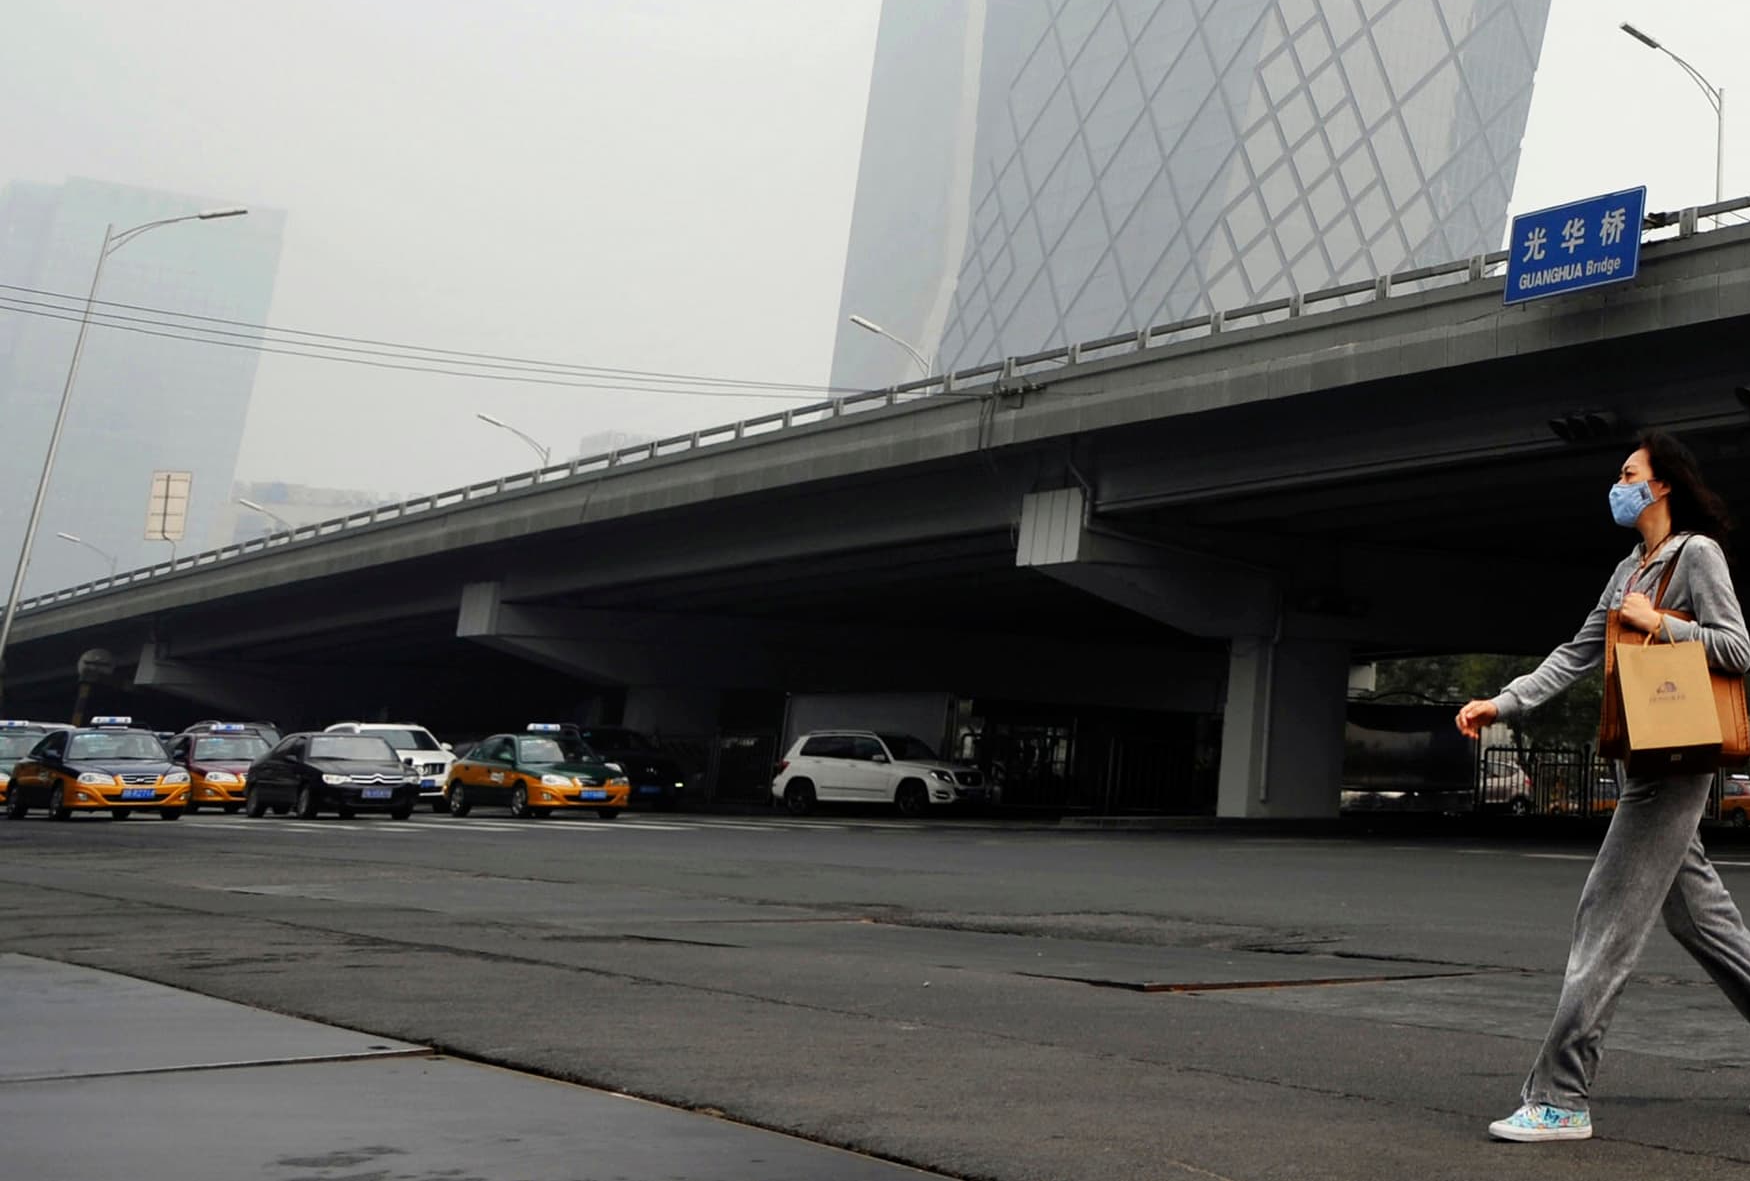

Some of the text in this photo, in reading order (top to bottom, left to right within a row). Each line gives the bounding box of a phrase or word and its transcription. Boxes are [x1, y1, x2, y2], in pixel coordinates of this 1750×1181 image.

[1523, 208, 1627, 262] 光华桥
[1519, 256, 1622, 290] GUANGHUA Bridge
